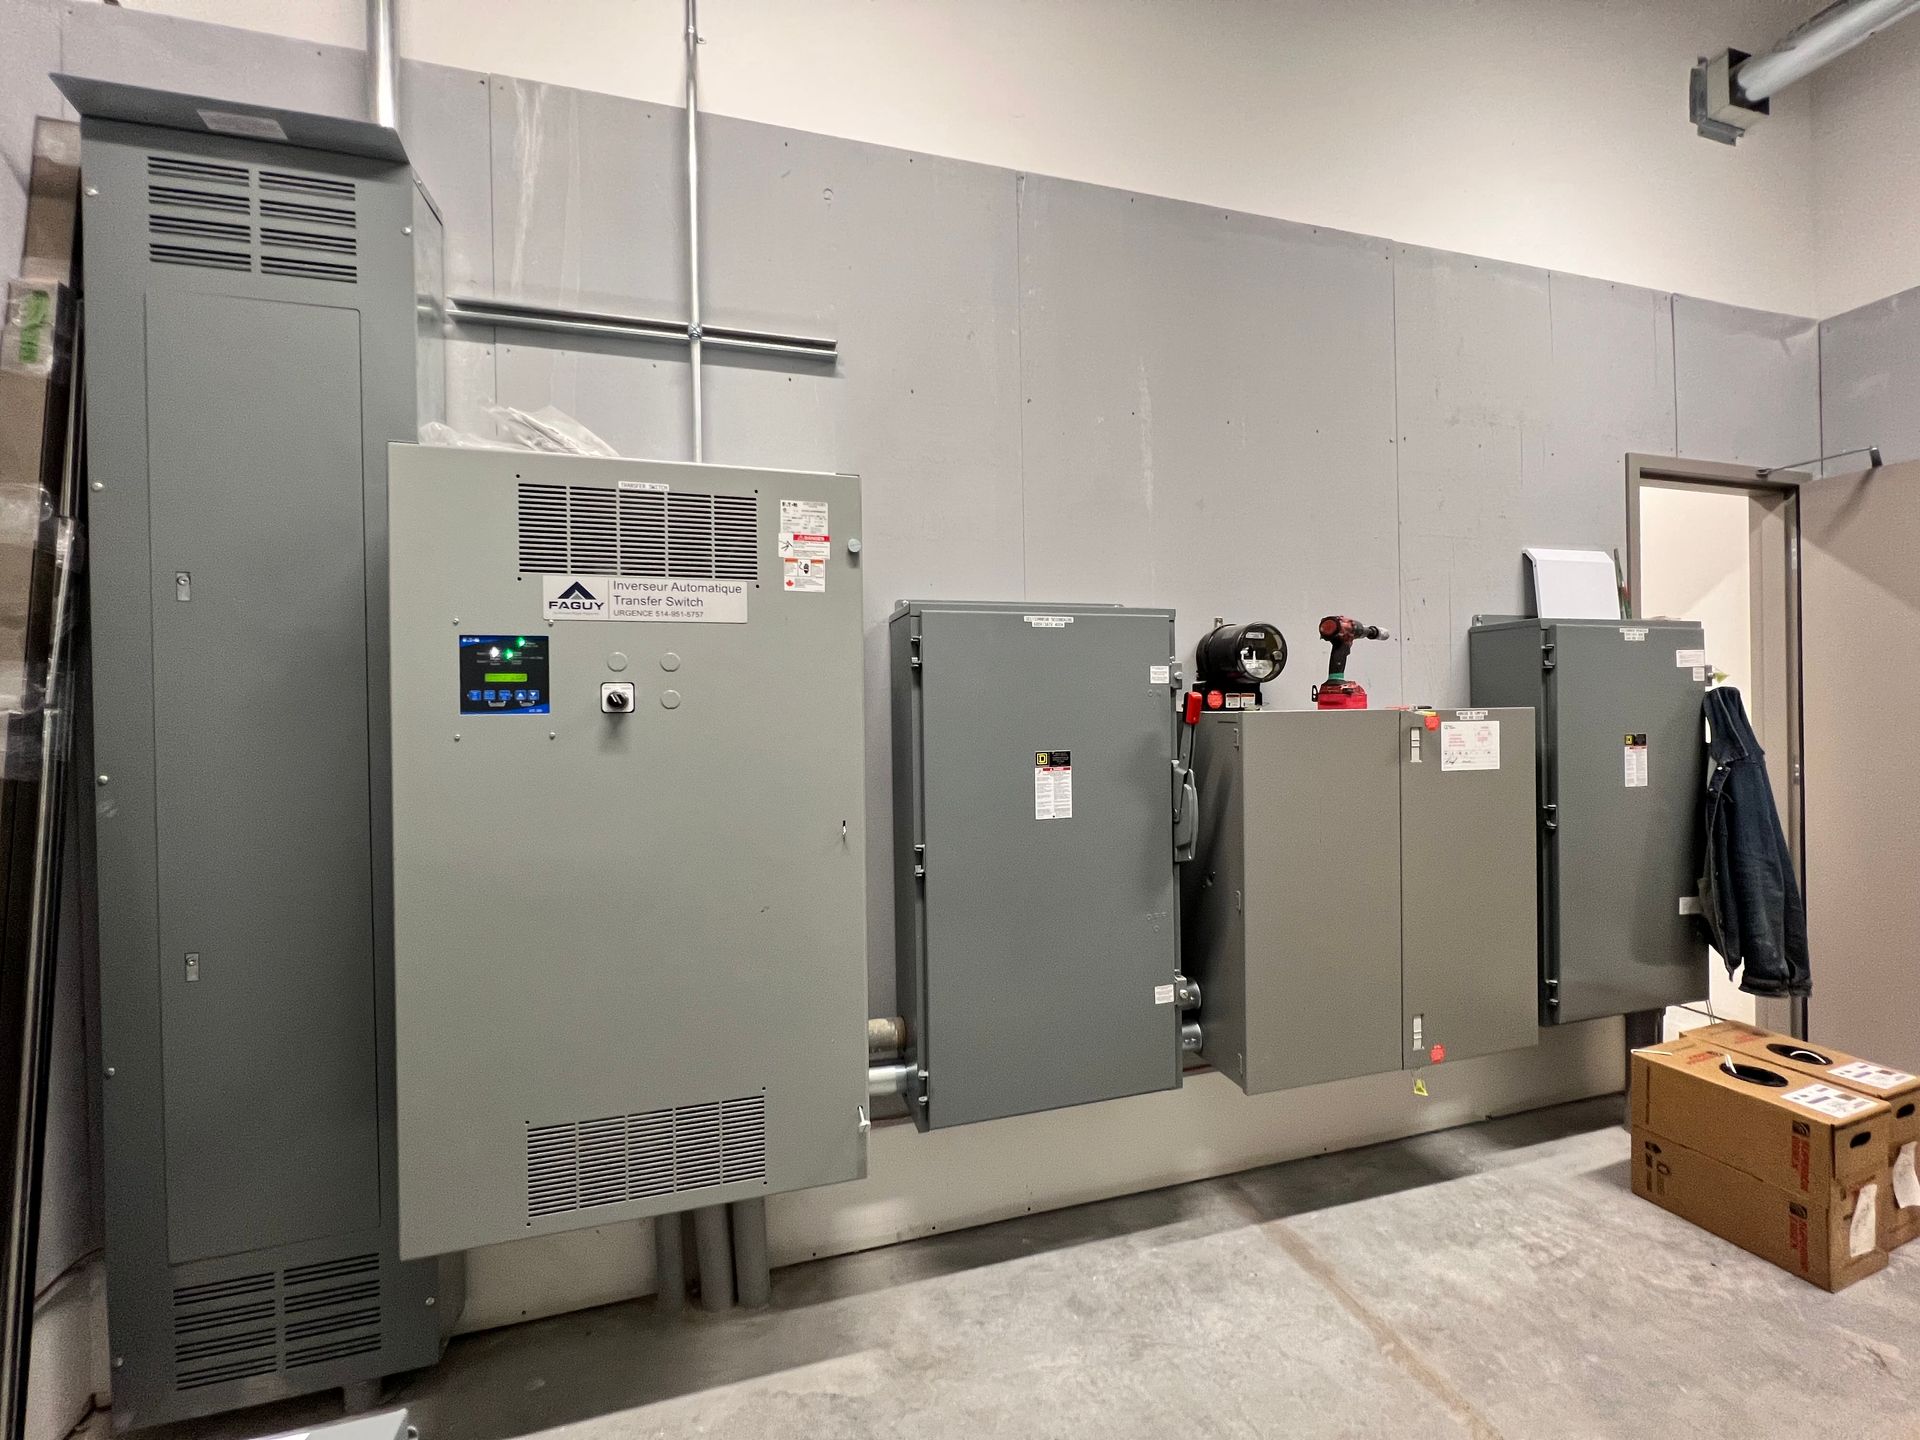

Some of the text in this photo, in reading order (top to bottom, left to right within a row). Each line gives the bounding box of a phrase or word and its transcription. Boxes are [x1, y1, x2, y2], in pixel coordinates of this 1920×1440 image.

[613, 580, 742, 596] Inverseur Automatique
[549, 601, 605, 611] FAGUY
[613, 595, 704, 607] Transfer Switch
[613, 609, 705, 618] URGENCE 514-951-5757
